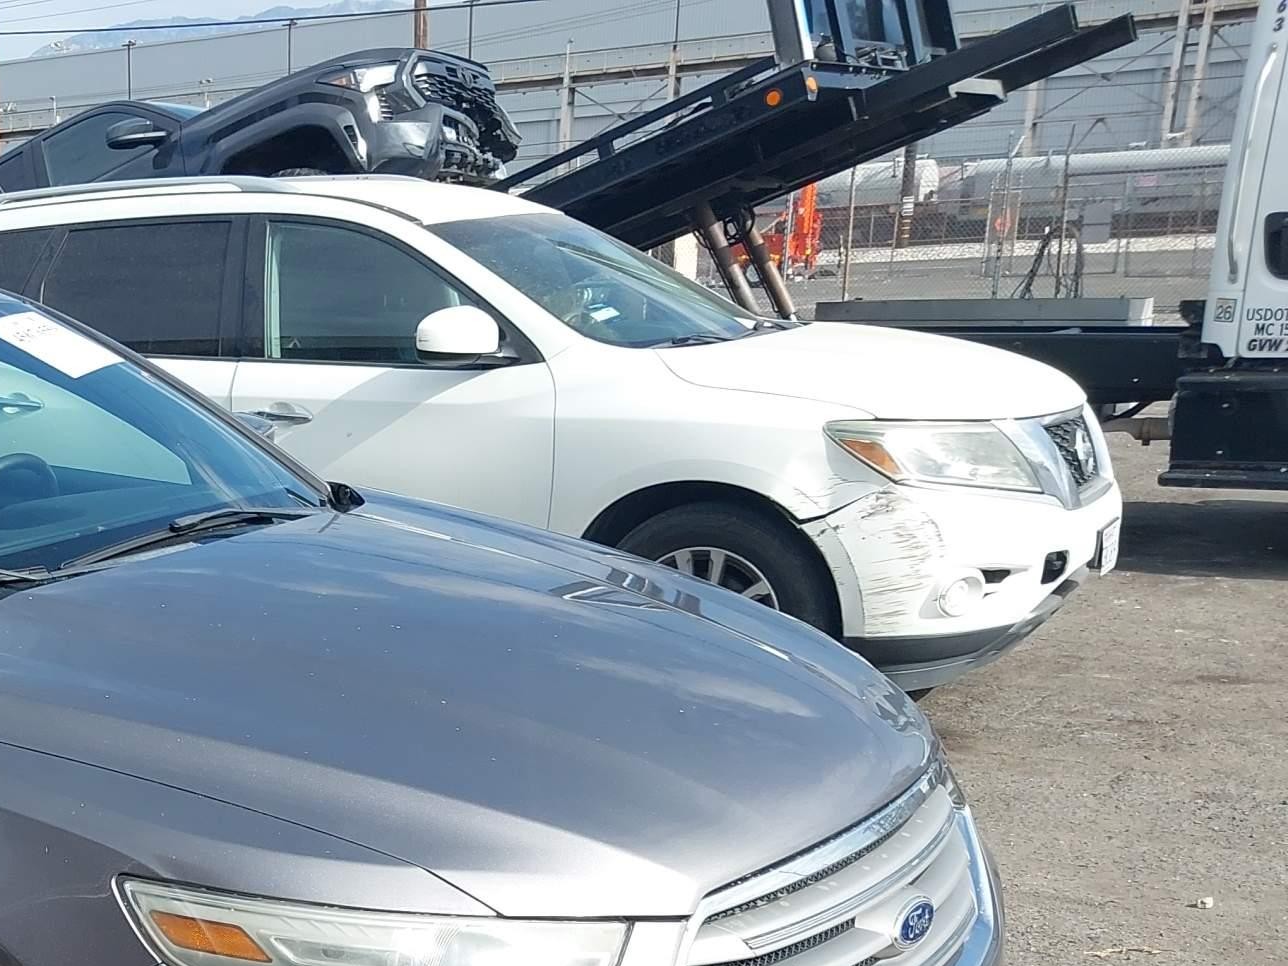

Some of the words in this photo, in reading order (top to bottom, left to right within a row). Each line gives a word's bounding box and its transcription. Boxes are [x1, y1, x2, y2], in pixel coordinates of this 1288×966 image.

[1215, 305, 1233, 320] 26
[1254, 323, 1275, 336] MC
[1247, 339, 1283, 352] GVW
[908, 907, 931, 939] Ford
